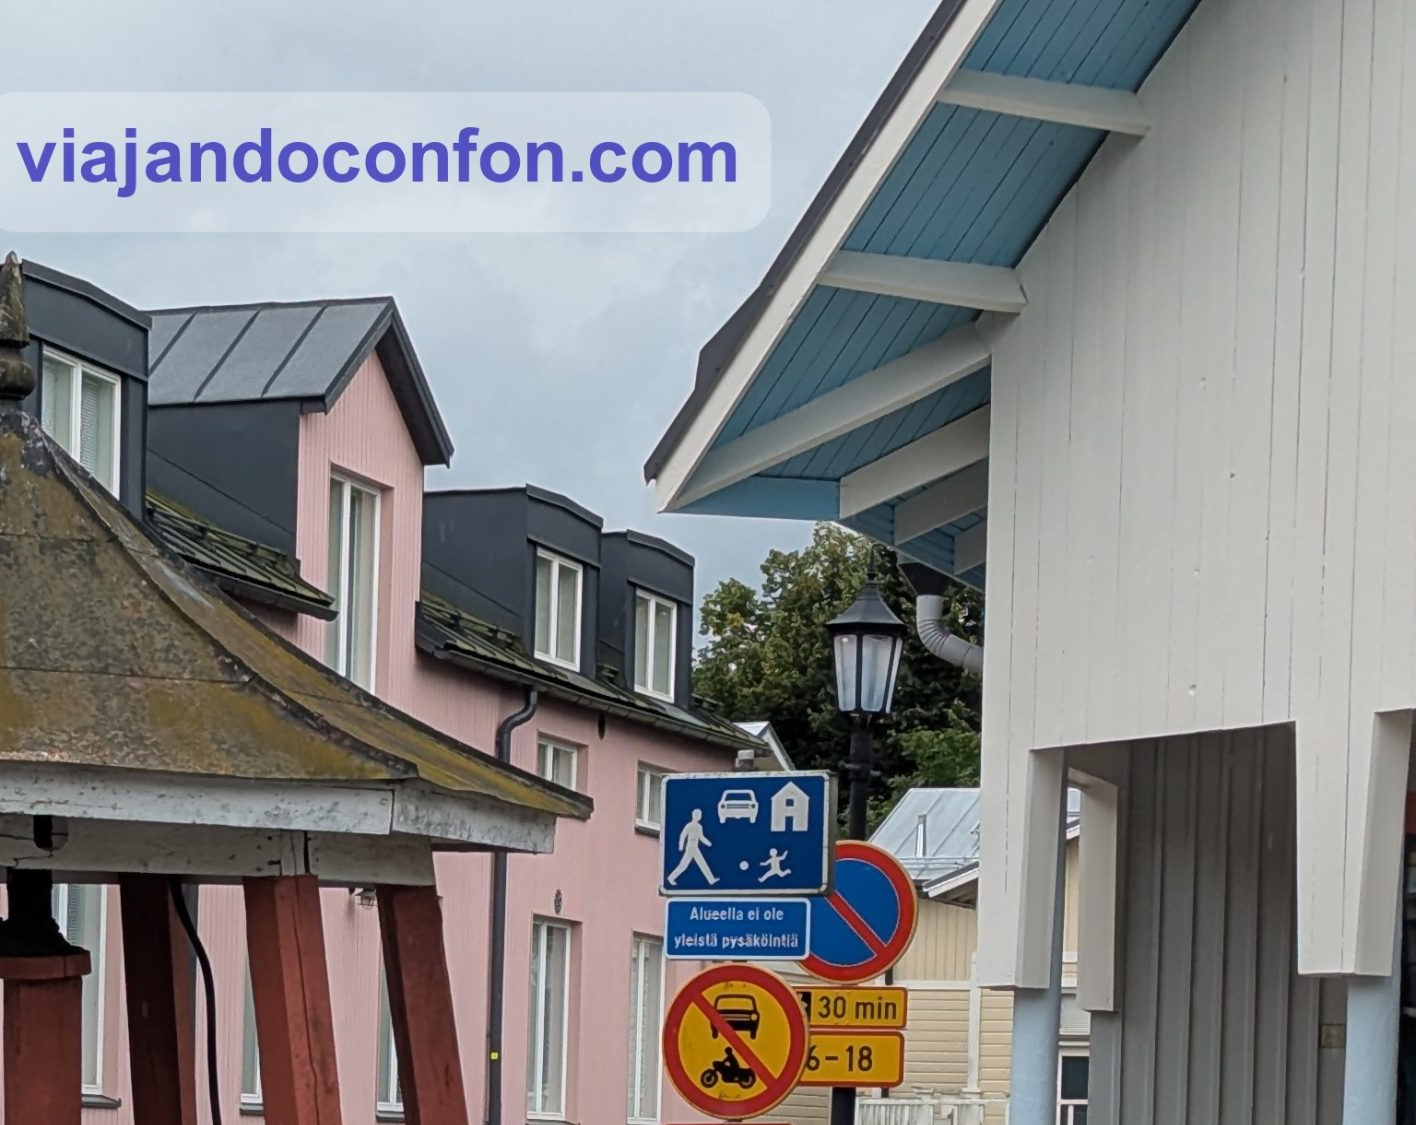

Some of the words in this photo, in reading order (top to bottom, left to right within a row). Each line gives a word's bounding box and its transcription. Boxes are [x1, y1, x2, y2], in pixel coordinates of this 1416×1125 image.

[689, 906, 744, 921] Alueella
[747, 907, 760, 921] ei
[763, 907, 784, 921] ole
[674, 932, 718, 949] yleistä
[722, 933, 799, 949] pysäköintiä
[818, 995, 847, 1019] 30
[855, 996, 897, 1020] min
